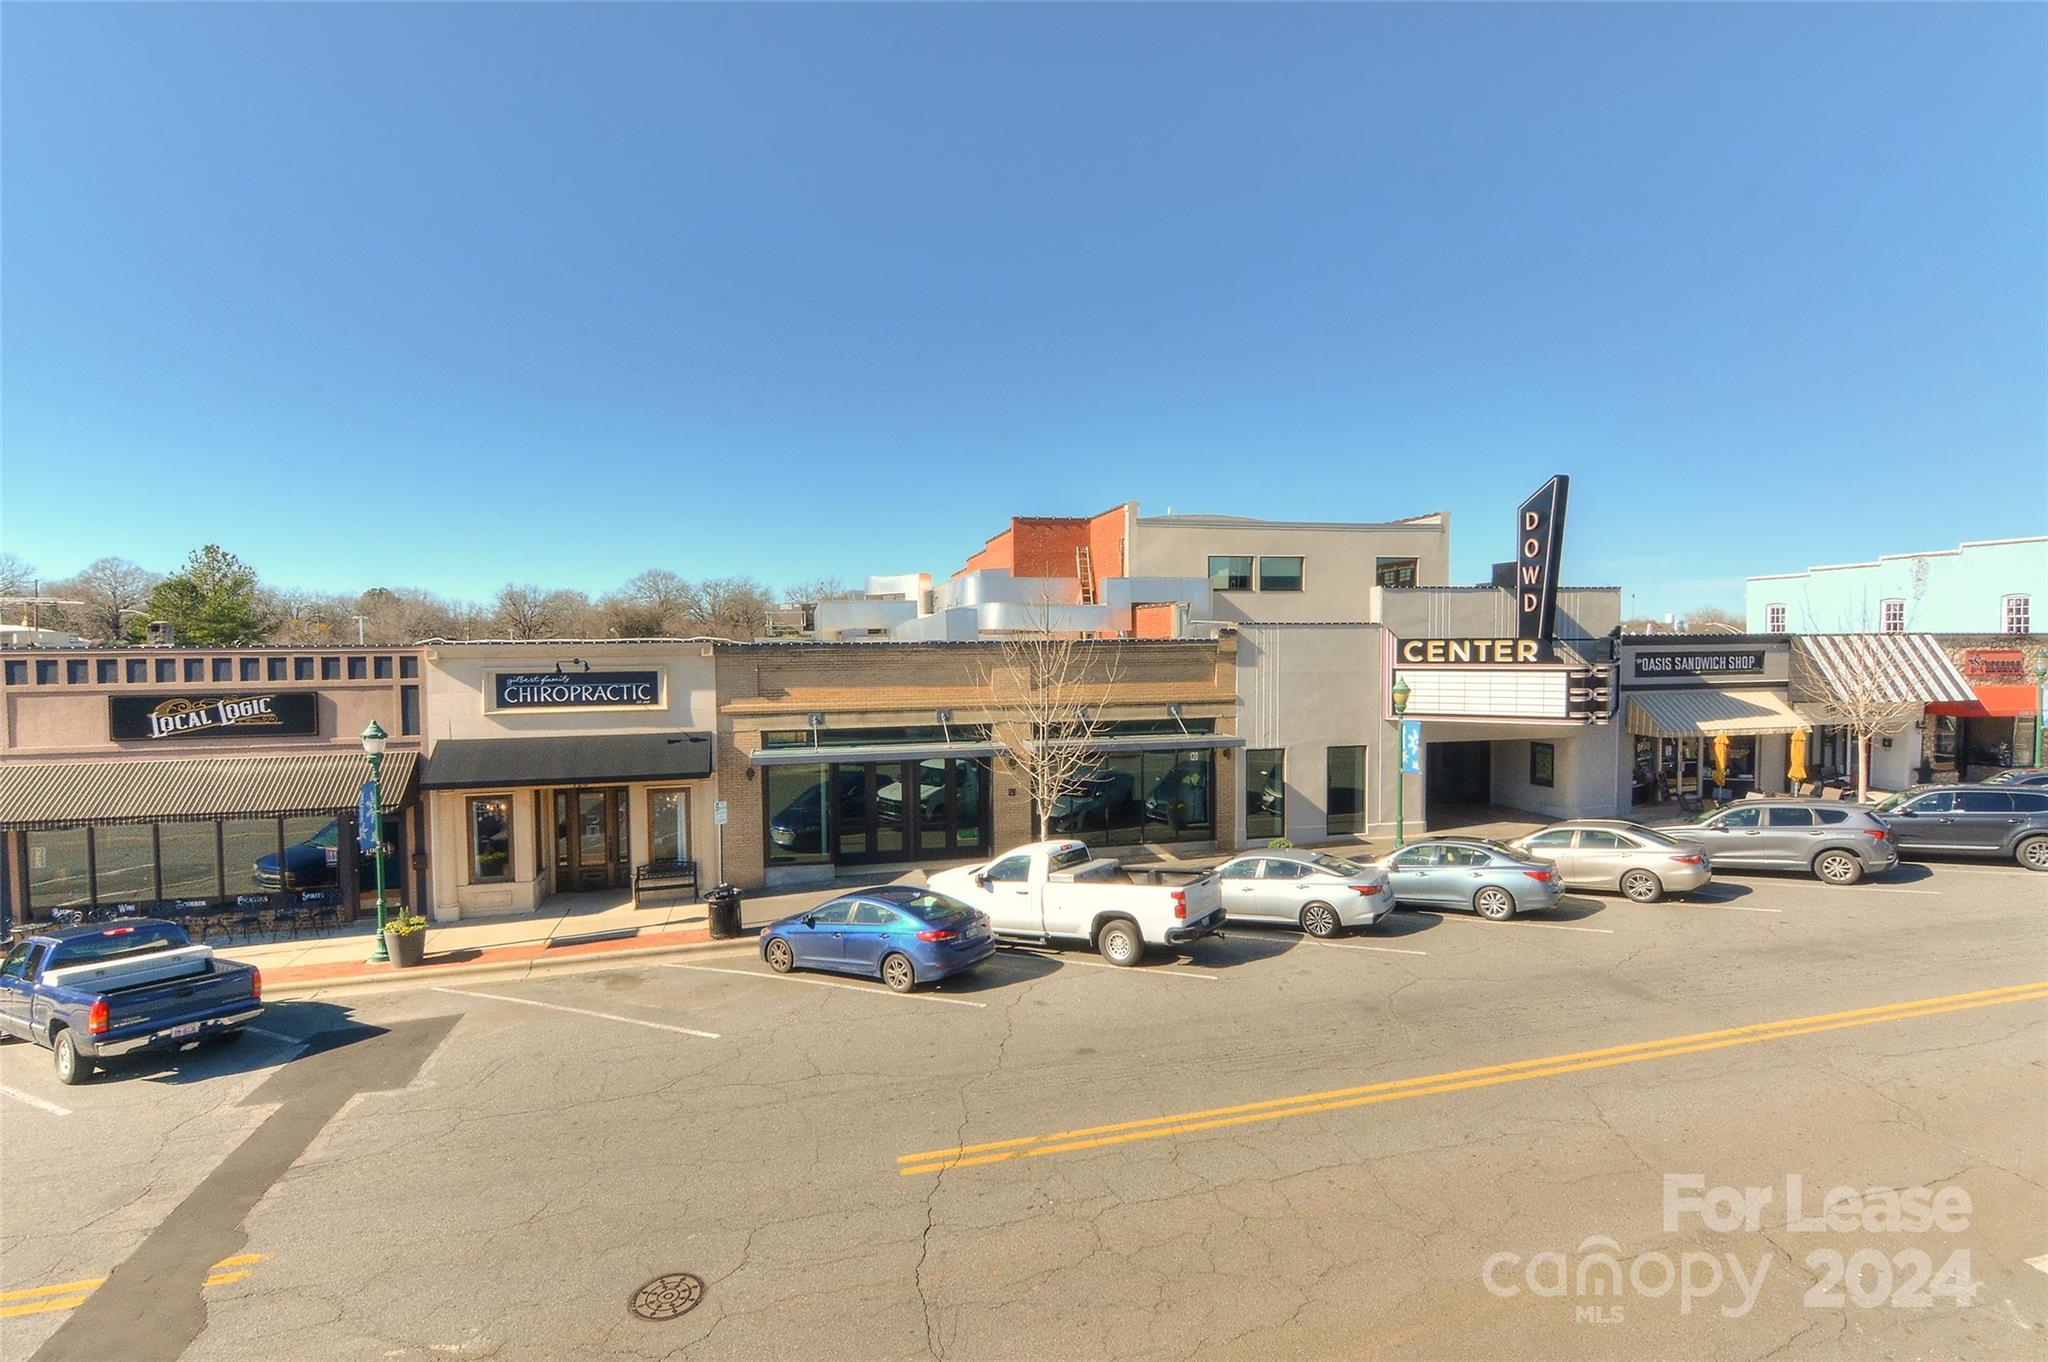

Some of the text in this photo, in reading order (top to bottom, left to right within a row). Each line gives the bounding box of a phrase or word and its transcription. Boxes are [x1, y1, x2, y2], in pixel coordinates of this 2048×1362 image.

[1522, 511, 1540, 613] DOWD
[1403, 639, 1539, 663] CENTER
[1642, 657, 1672, 671] OASIS
[1675, 656, 1726, 670] SANDWICH
[1728, 655, 1755, 669] SHOP
[506, 674, 570, 687] gilbert family
[504, 684, 651, 703] CHIROPRACTIC
[149, 697, 272, 738] LOCAL LOGIC
[1189, 751, 1199, 761] 120
